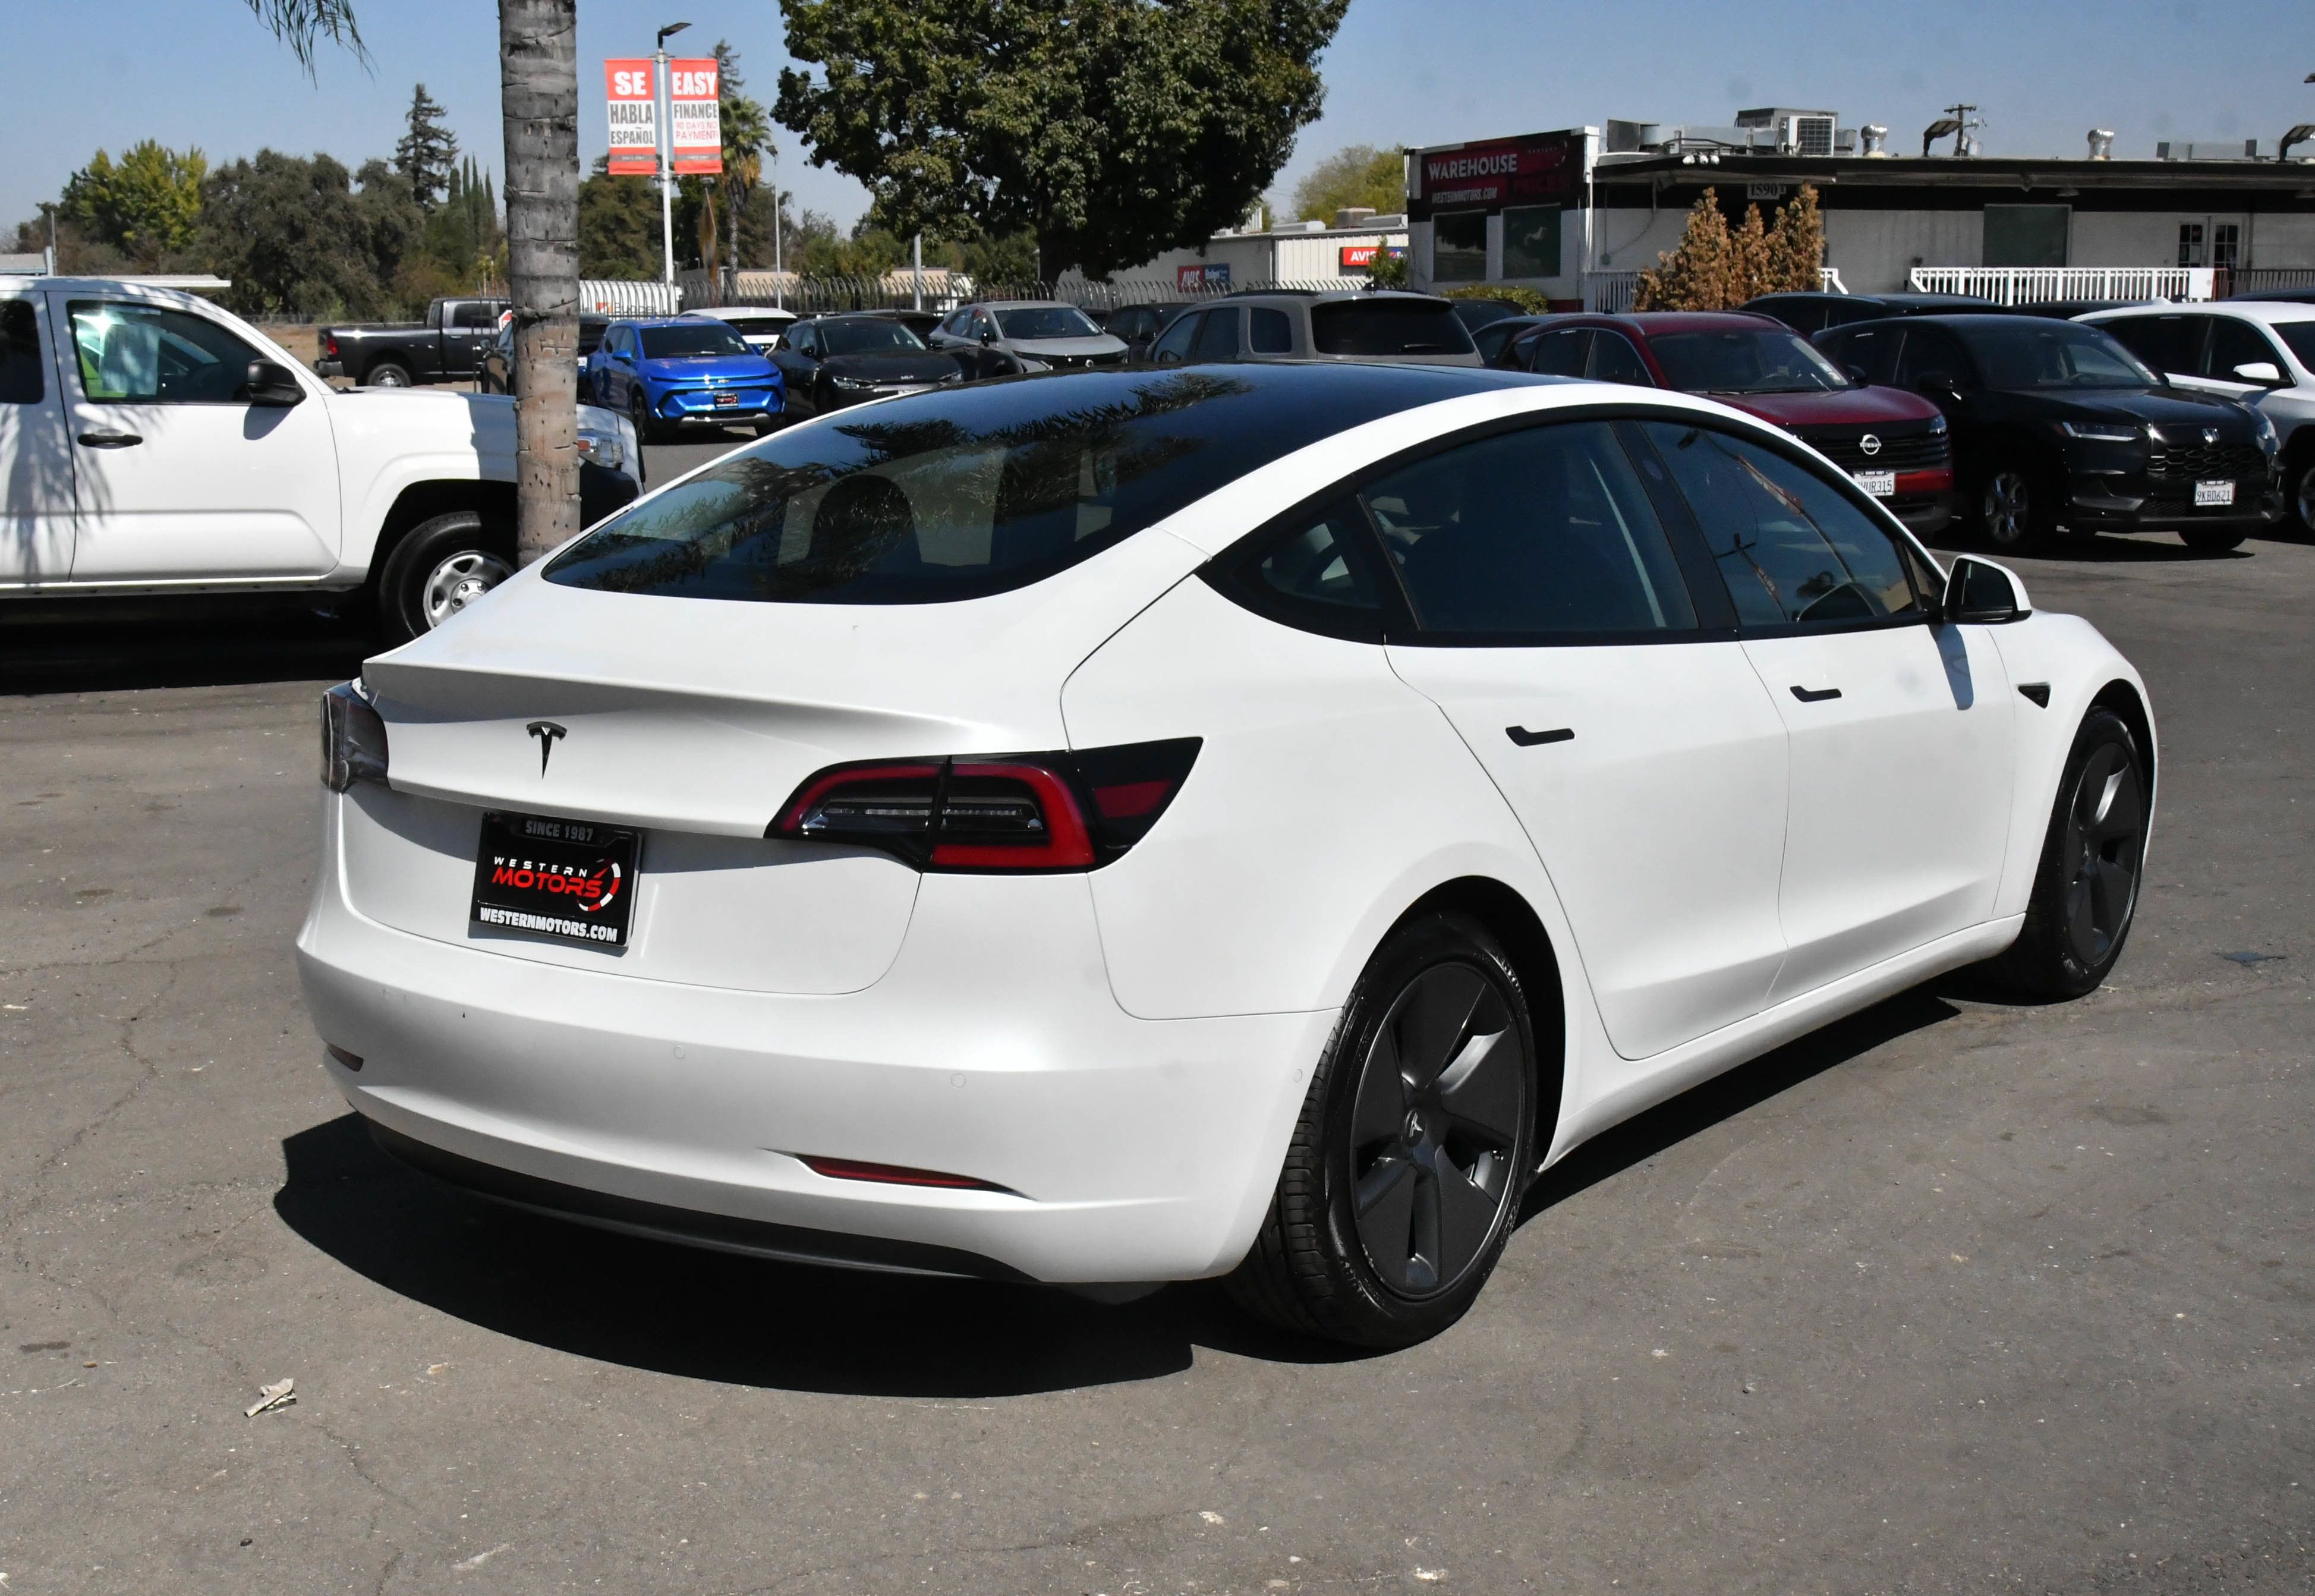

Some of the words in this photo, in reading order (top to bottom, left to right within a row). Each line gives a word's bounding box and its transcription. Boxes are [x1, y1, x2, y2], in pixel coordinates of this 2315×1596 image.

[614, 71, 647, 95] SE
[672, 72, 717, 95] EASY
[610, 104, 653, 124] HABLA
[674, 103, 717, 119] FINANCE
[611, 127, 654, 144] ESPAÑOL
[1428, 153, 1517, 181] WAREHOUSE
[1431, 187, 1498, 204] WESTERNMOTORS.COM
[1750, 182, 1778, 196] 1590
[525, 820, 560, 837] SINCE
[565, 825, 593, 842] 1987
[494, 857, 587, 877] WESTERN
[492, 866, 603, 898] MOTORS
[480, 907, 618, 942] WESTERNMOTORS.COM
